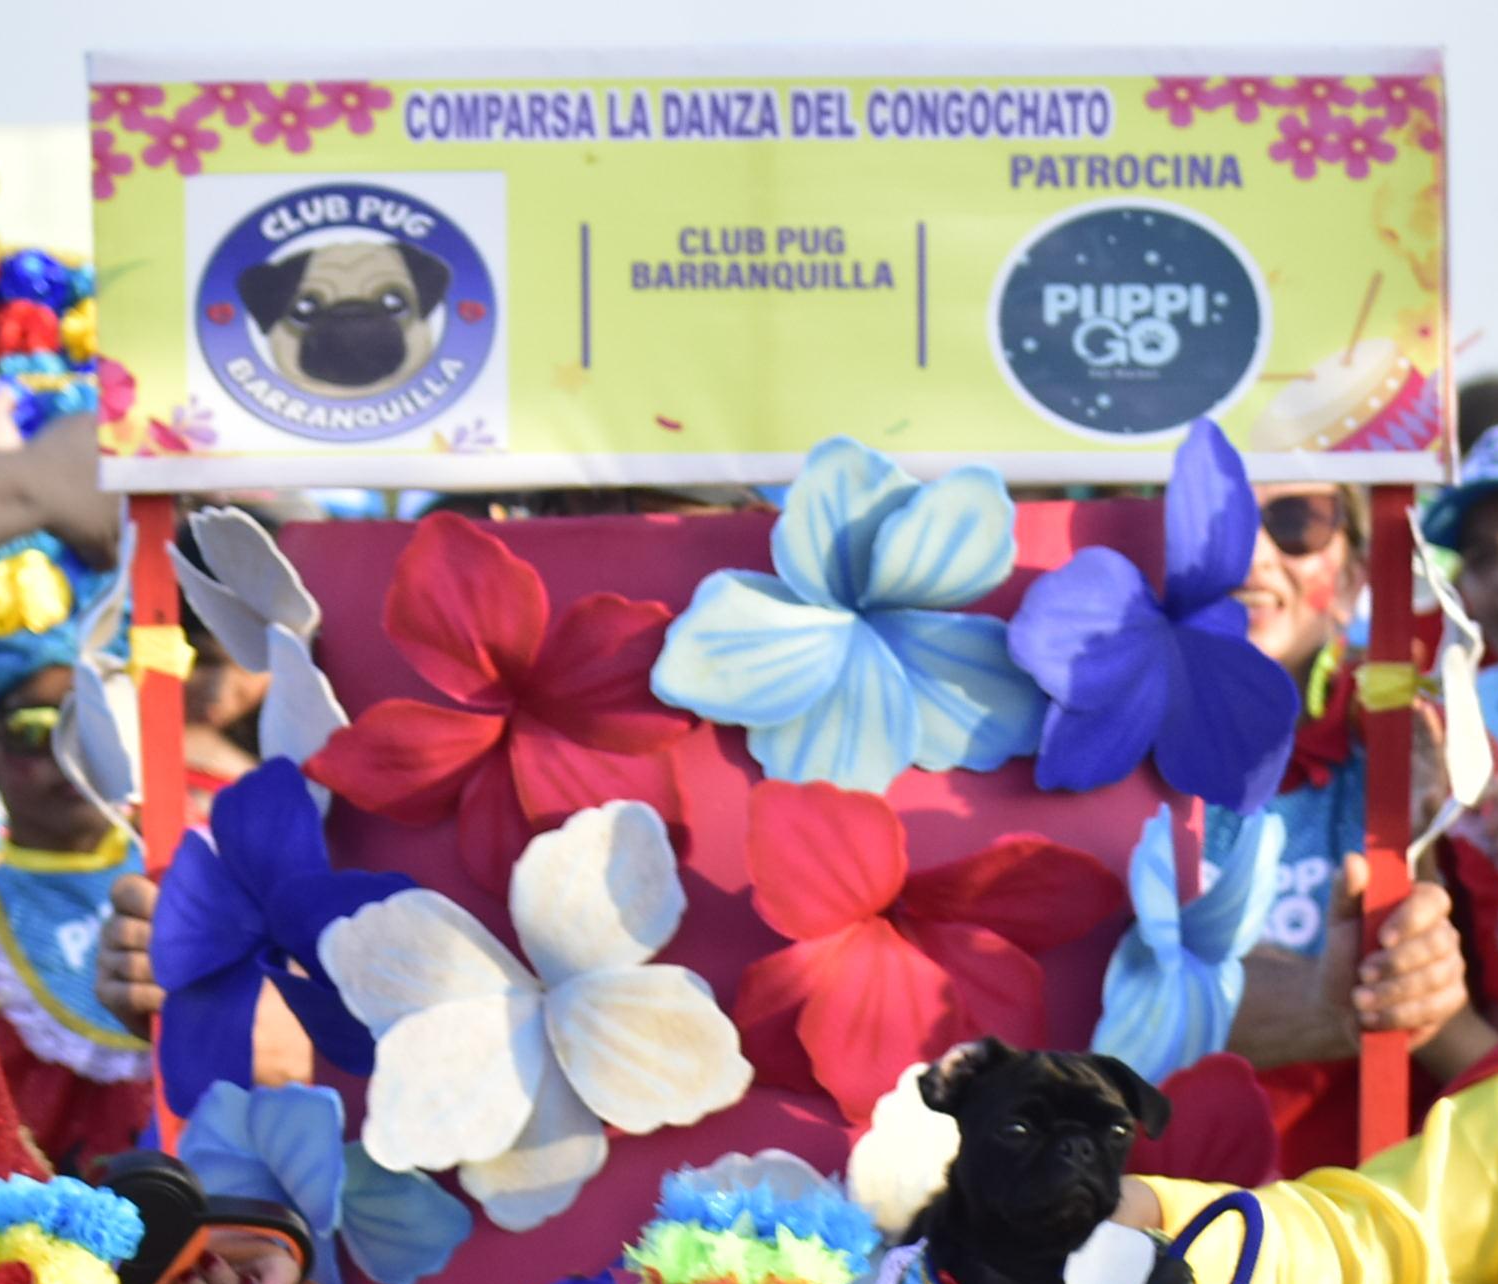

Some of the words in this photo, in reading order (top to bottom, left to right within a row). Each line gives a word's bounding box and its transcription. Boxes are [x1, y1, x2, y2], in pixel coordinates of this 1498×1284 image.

[405, 92, 596, 139] COMPARSA
[607, 92, 652, 138] LA
[662, 92, 779, 138] DANZA
[790, 92, 856, 138] DEL
[867, 92, 1107, 138] CONGOCHATO
[1008, 154, 1244, 190] PATROCINA
[260, 194, 349, 240] CLUB
[358, 196, 434, 237] PUG
[678, 228, 766, 256] CLUB
[775, 228, 845, 256] PUG
[631, 263, 894, 291] BARRANQUILLA
[1042, 282, 1208, 326] PUPPI
[1071, 317, 1181, 368] GO
[227, 358, 463, 429] BARRANQUILLA
